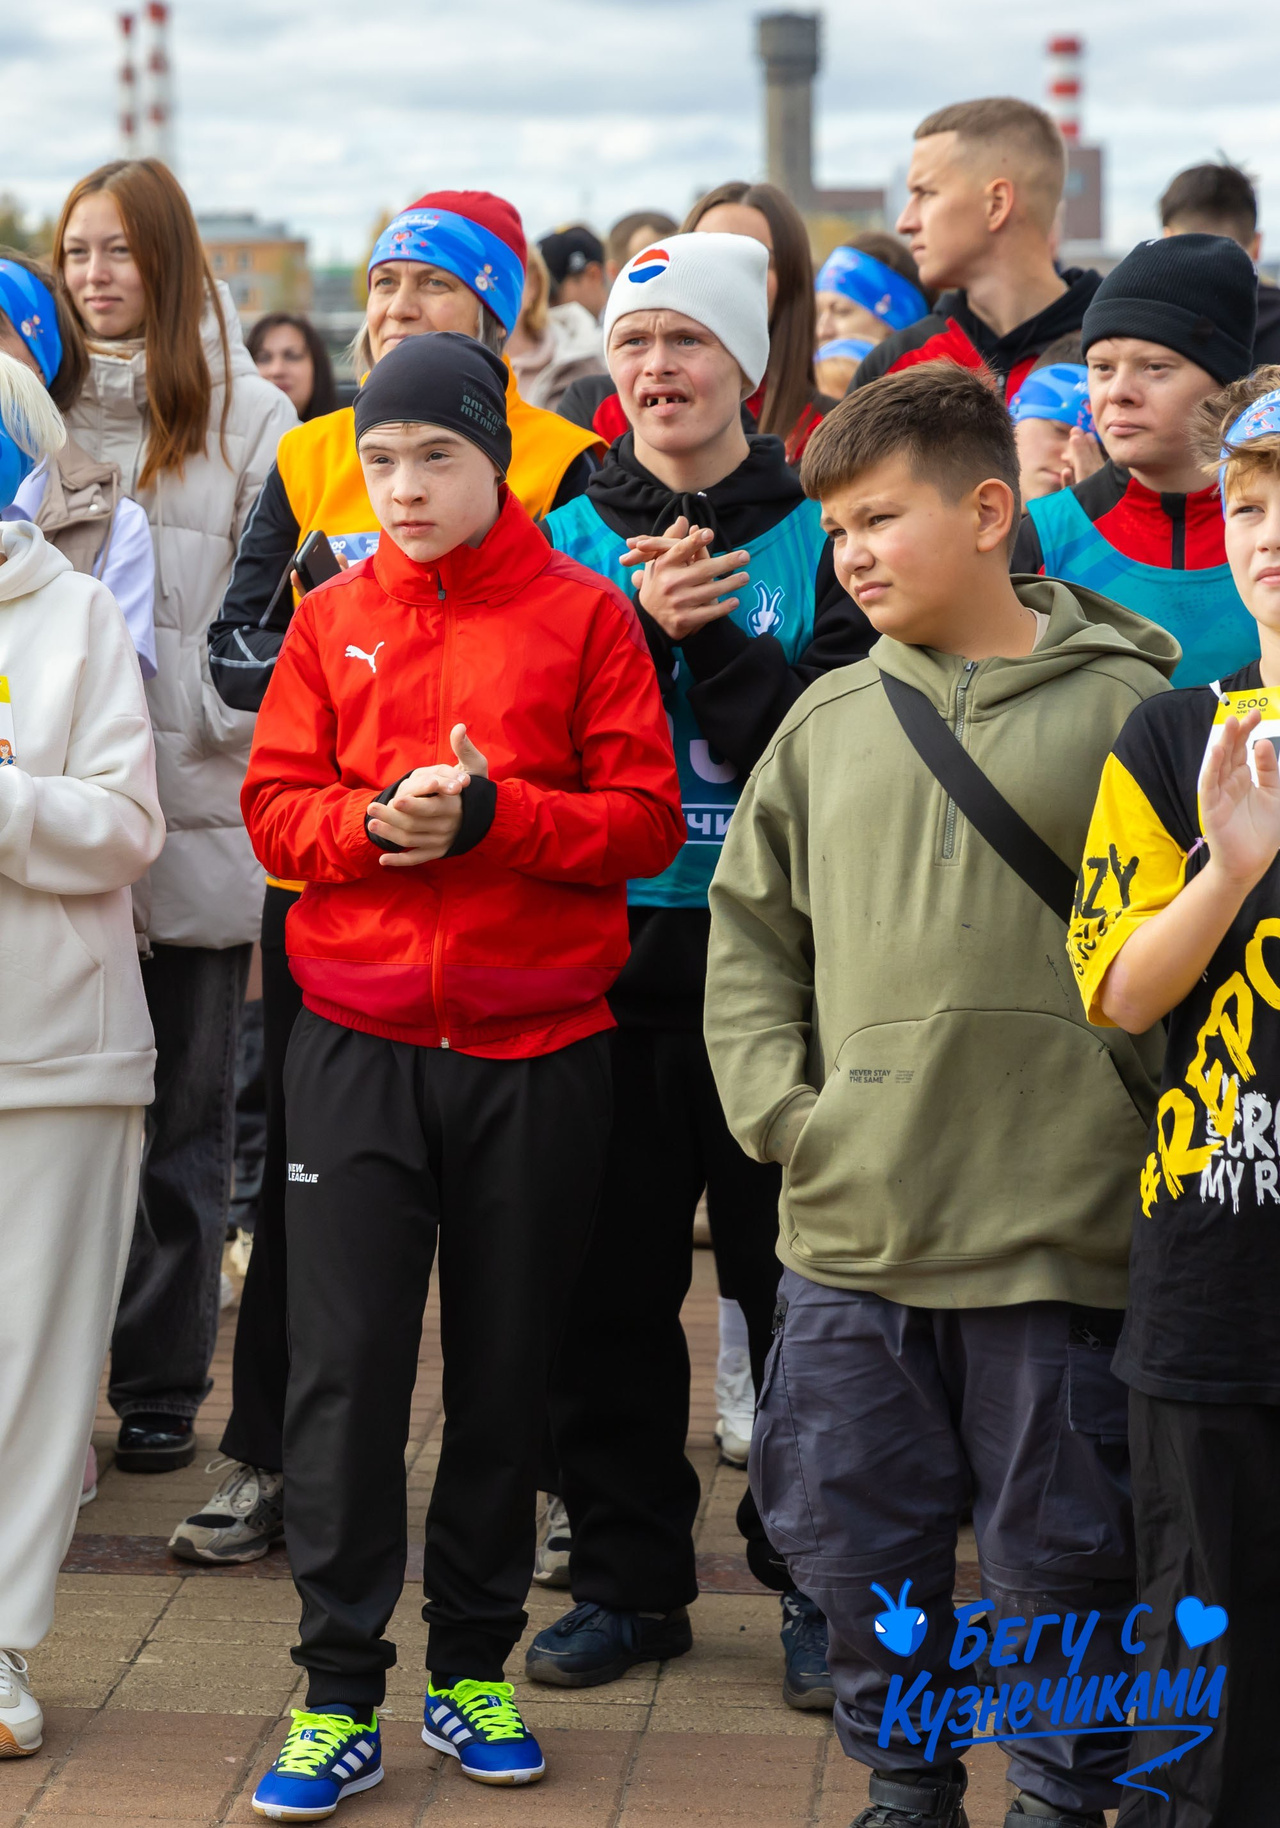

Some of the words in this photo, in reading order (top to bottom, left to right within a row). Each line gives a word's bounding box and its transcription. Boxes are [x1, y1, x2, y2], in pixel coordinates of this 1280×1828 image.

[1236, 697, 1269, 710] 500
[849, 1069, 873, 1077] NEVER
[873, 1069, 891, 1077] STAY
[849, 1076, 862, 1084] THE
[863, 1076, 884, 1084] SAME
[288, 1172, 319, 1183] LEAGUE
[1199, 1158, 1245, 1215] MY
